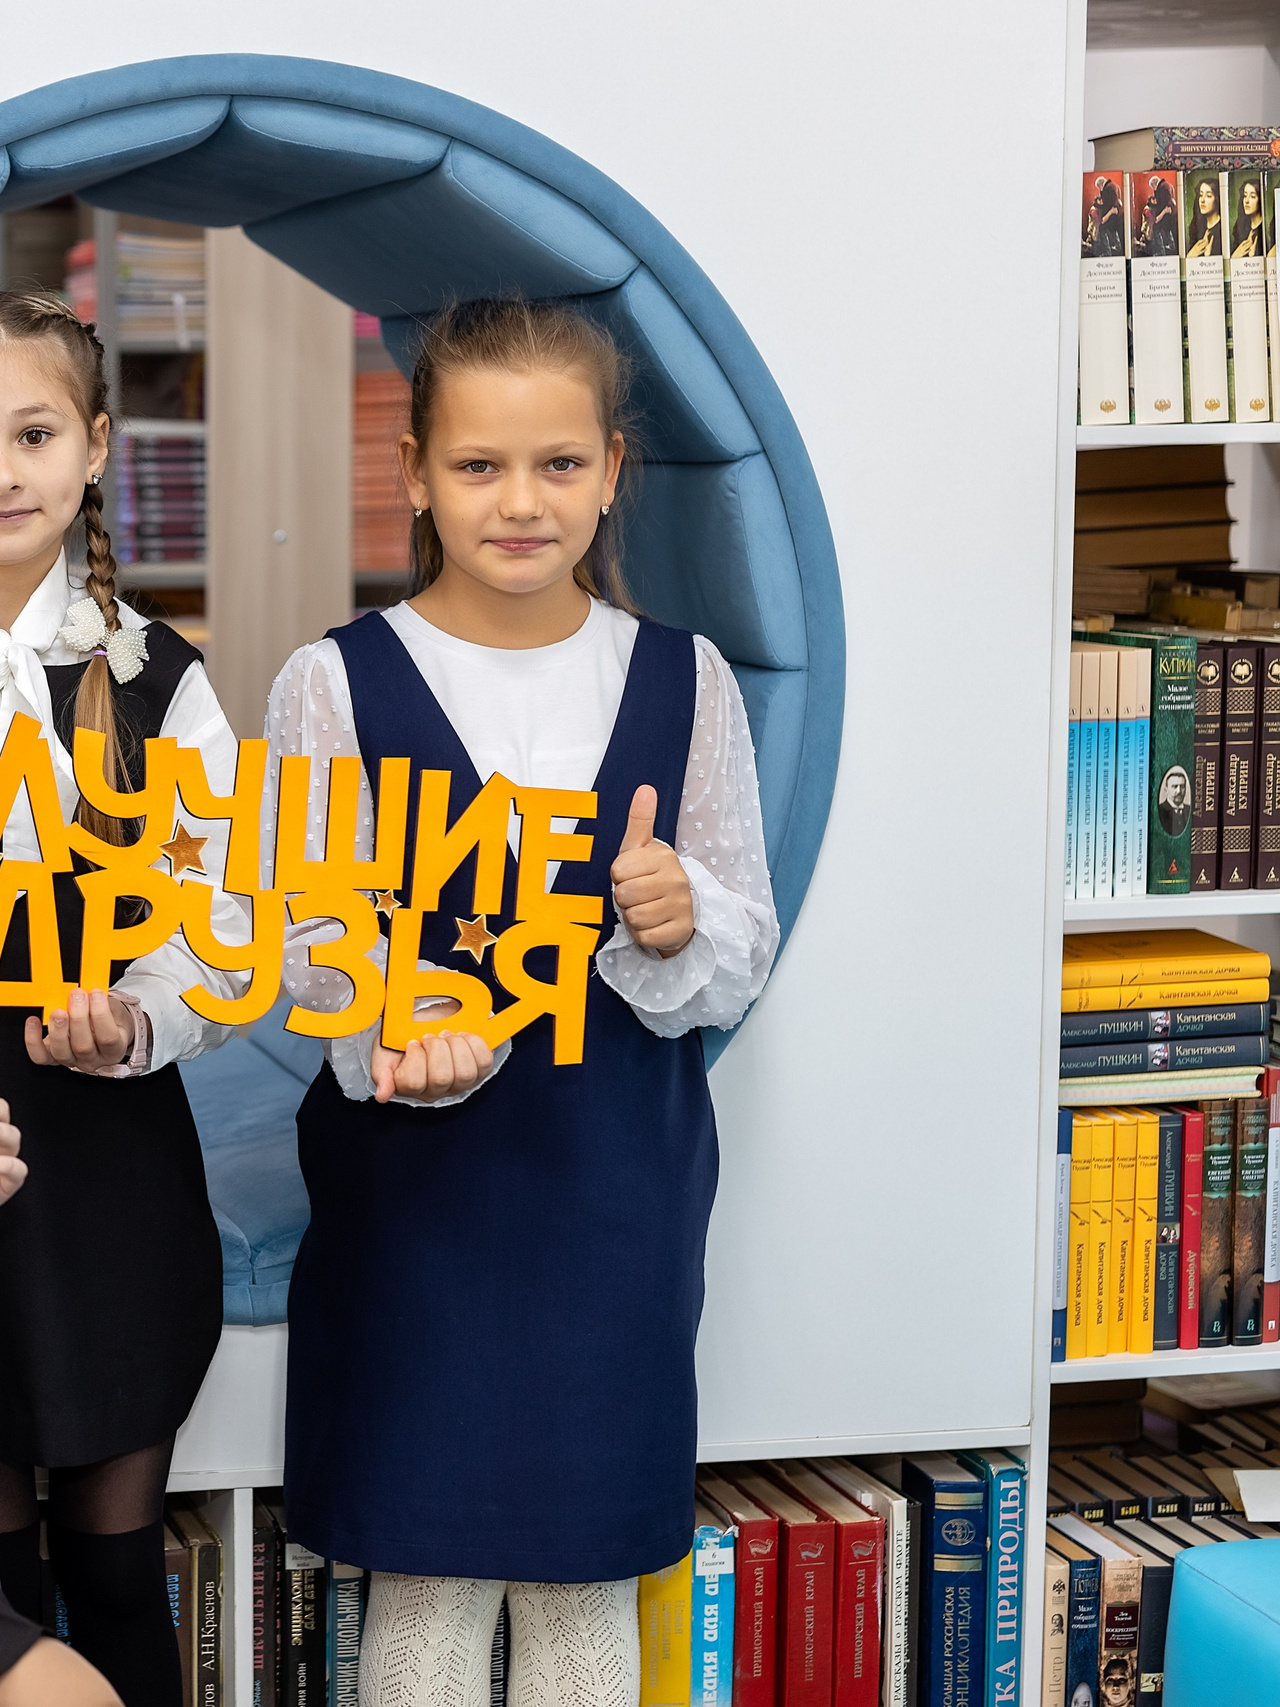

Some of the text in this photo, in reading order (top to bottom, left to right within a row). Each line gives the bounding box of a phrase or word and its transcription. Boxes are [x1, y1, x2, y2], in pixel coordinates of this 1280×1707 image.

[1159, 657, 1196, 675] КУПРИН
[1167, 684, 1189, 692] Малое
[1158, 702, 1195, 711] сочинений
[1161, 693, 1193, 702] собрание
[1193, 755, 1207, 818] Александр
[1205, 761, 1216, 812] КУПРИН
[1226, 753, 1240, 817] Александр
[1238, 760, 1249, 810] КУПРИН
[1262, 752, 1277, 816] Александр
[1159, 989, 1239, 999] Капитанская дочка
[1161, 967, 1213, 977] Капитанская
[1099, 1020, 1144, 1035] ПУШКИН
[1176, 1012, 1236, 1024] Капитанская
[1176, 1024, 1204, 1033] дочка
[1097, 1053, 1143, 1067] ПУШКИН
[1175, 1044, 1236, 1056] Капитанская
[1175, 1057, 1203, 1066] дочка
[1164, 1169, 1175, 1217] ПУШКИН
[1074, 1243, 1085, 1327] Капитанская дочка
[1097, 1241, 1106, 1297] Капитанская
[1117, 1239, 1128, 1322] Капитанская дочка
[1142, 1239, 1152, 1322] Капитанская дочка
[1167, 1251, 1178, 1314] Капитанская
[1187, 1249, 1198, 1310] Дубровский
[996, 1476, 1024, 1644] ПРИРОДЫ
[253, 1542, 265, 1670] ШКОЛЬНИКА
[1073, 1578, 1099, 1594] ТЮТЧЕВ
[201, 1581, 218, 1671] А.Н.Краснов
[304, 1603, 316, 1631] ДЛЯ
[336, 1580, 360, 1658] ШКОЛЬНИКА
[703, 1603, 719, 1642] ДЛЯ
[753, 1566, 765, 1678] ПРИМОРСКИЙ КРАЙ
[804, 1570, 815, 1681] ПРИМОРСКИЙ КРАЙ
[853, 1568, 865, 1678] ПРИМОРСКИЙ КРАЙ
[893, 1529, 903, 1702] РАССКАЗЫ РУССКОМ ФЛОТЕ
[942, 1586, 955, 1657] РОССИЙСКАЯ
[955, 1586, 973, 1707] ЭНЦИКЛОПЕДИЯ
[297, 1662, 307, 1687] ВОЙН
[1049, 1656, 1064, 1693] Петр
